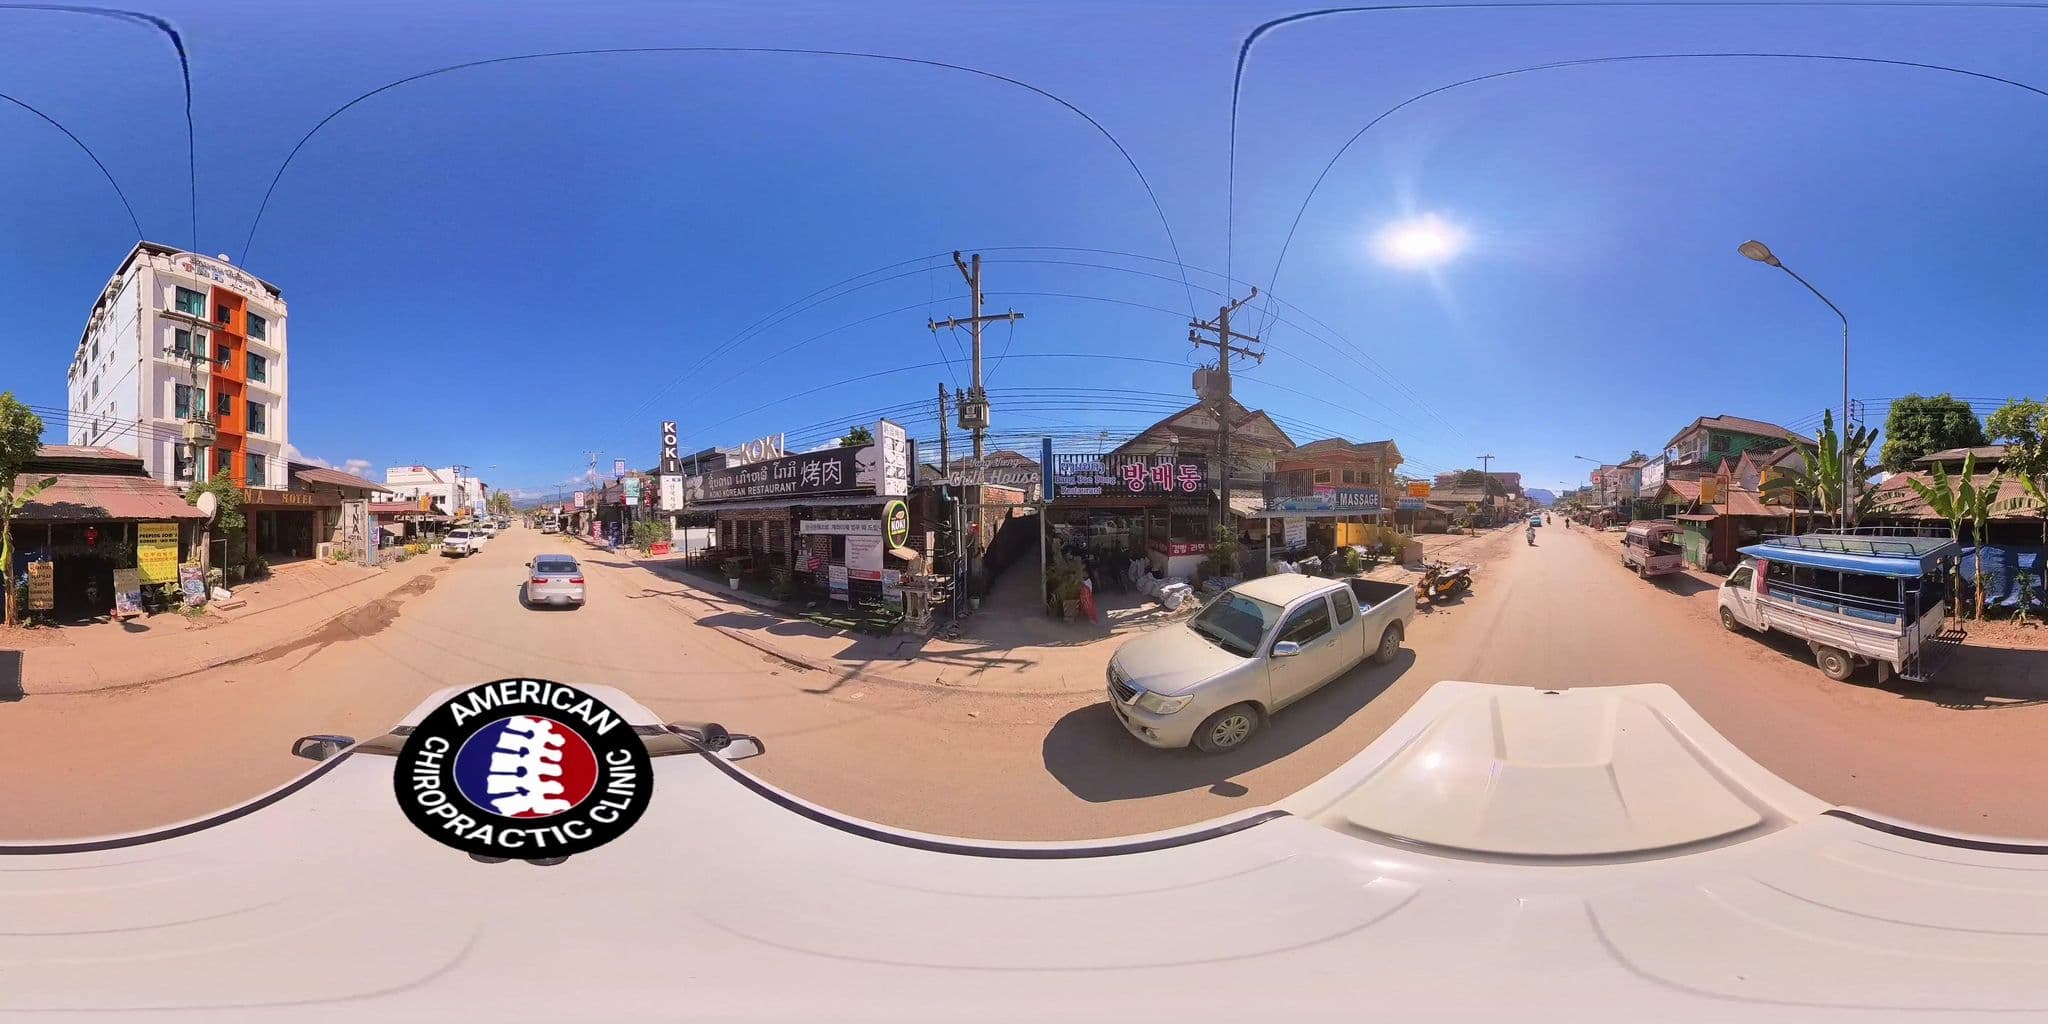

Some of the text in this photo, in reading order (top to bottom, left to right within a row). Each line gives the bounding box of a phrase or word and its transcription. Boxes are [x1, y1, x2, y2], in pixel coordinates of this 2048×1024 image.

[664, 422, 677, 472] KOKI
[741, 433, 785, 464] KOKI
[800, 458, 842, 488] 烤肉
[990, 469, 1039, 485] House
[1121, 462, 1202, 492] 방배동
[282, 493, 314, 504] HOTEL
[722, 487, 746, 497] KOREAN
[748, 481, 798, 496] RESTAURANT
[1340, 492, 1379, 505] MASSAGE
[352, 504, 360, 534] TNA
